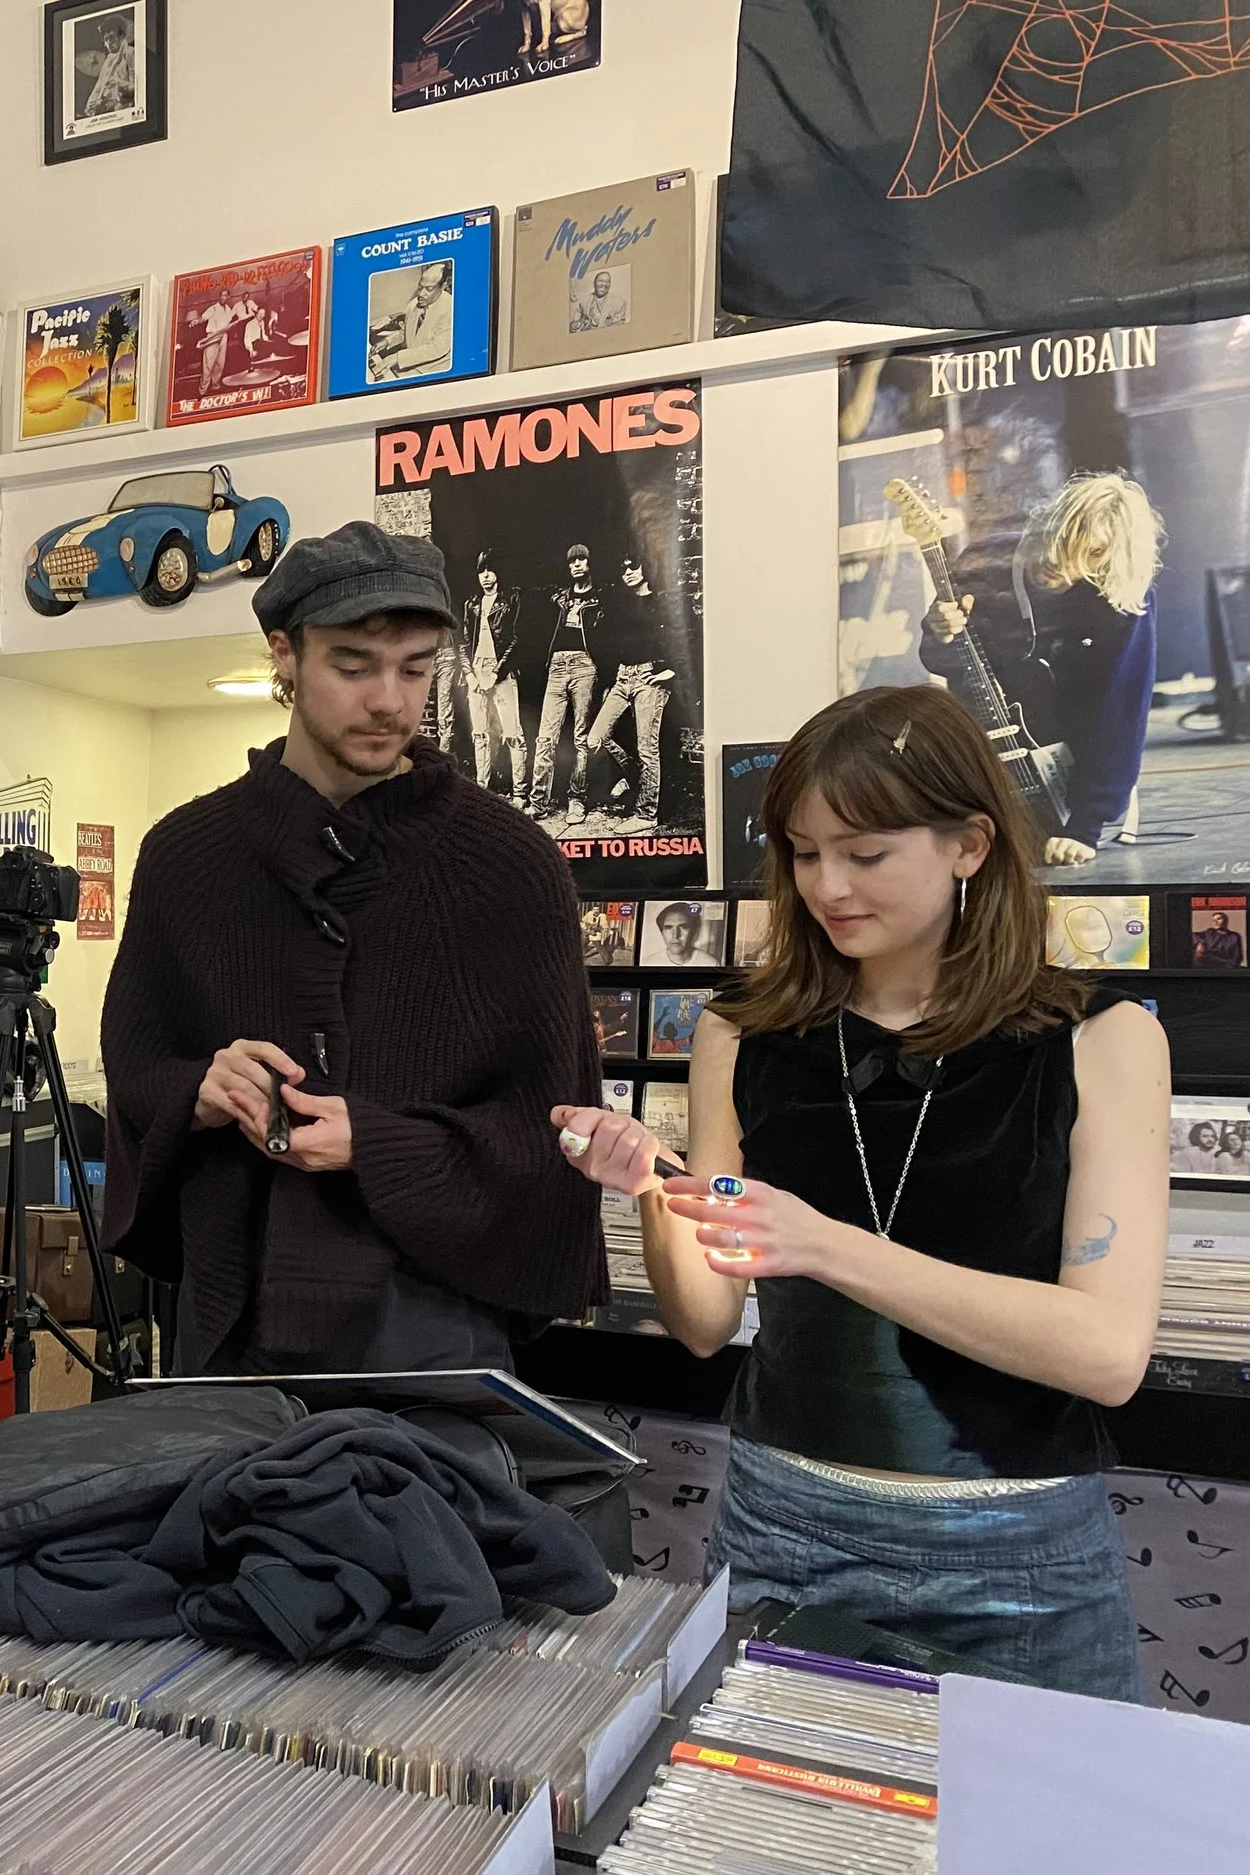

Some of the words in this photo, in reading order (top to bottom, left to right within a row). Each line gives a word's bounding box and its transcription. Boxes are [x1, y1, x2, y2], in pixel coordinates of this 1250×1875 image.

[361, 238, 412, 259] COUNT
[417, 227, 464, 248] BASIE
[544, 204, 634, 262] Muddy
[568, 217, 658, 280] Waters
[31, 306, 91, 334] Pacific
[27, 348, 93, 369] COLLECTION
[39, 328, 79, 361] Jazz
[929, 346, 1021, 399] KURT
[1030, 326, 1157, 383] COBAIN
[179, 398, 195, 414] THE
[198, 386, 249, 411] DOCTOR'S
[378, 388, 704, 487] RAMONES
[77, 831, 103, 847] BEATLES
[597, 839, 626, 858] TO
[628, 836, 704, 858] RUSSIA
[78, 857, 96, 872] ABBEY
[97, 857, 113, 872] ROAD
[1193, 1239, 1215, 1249] JAZZ
